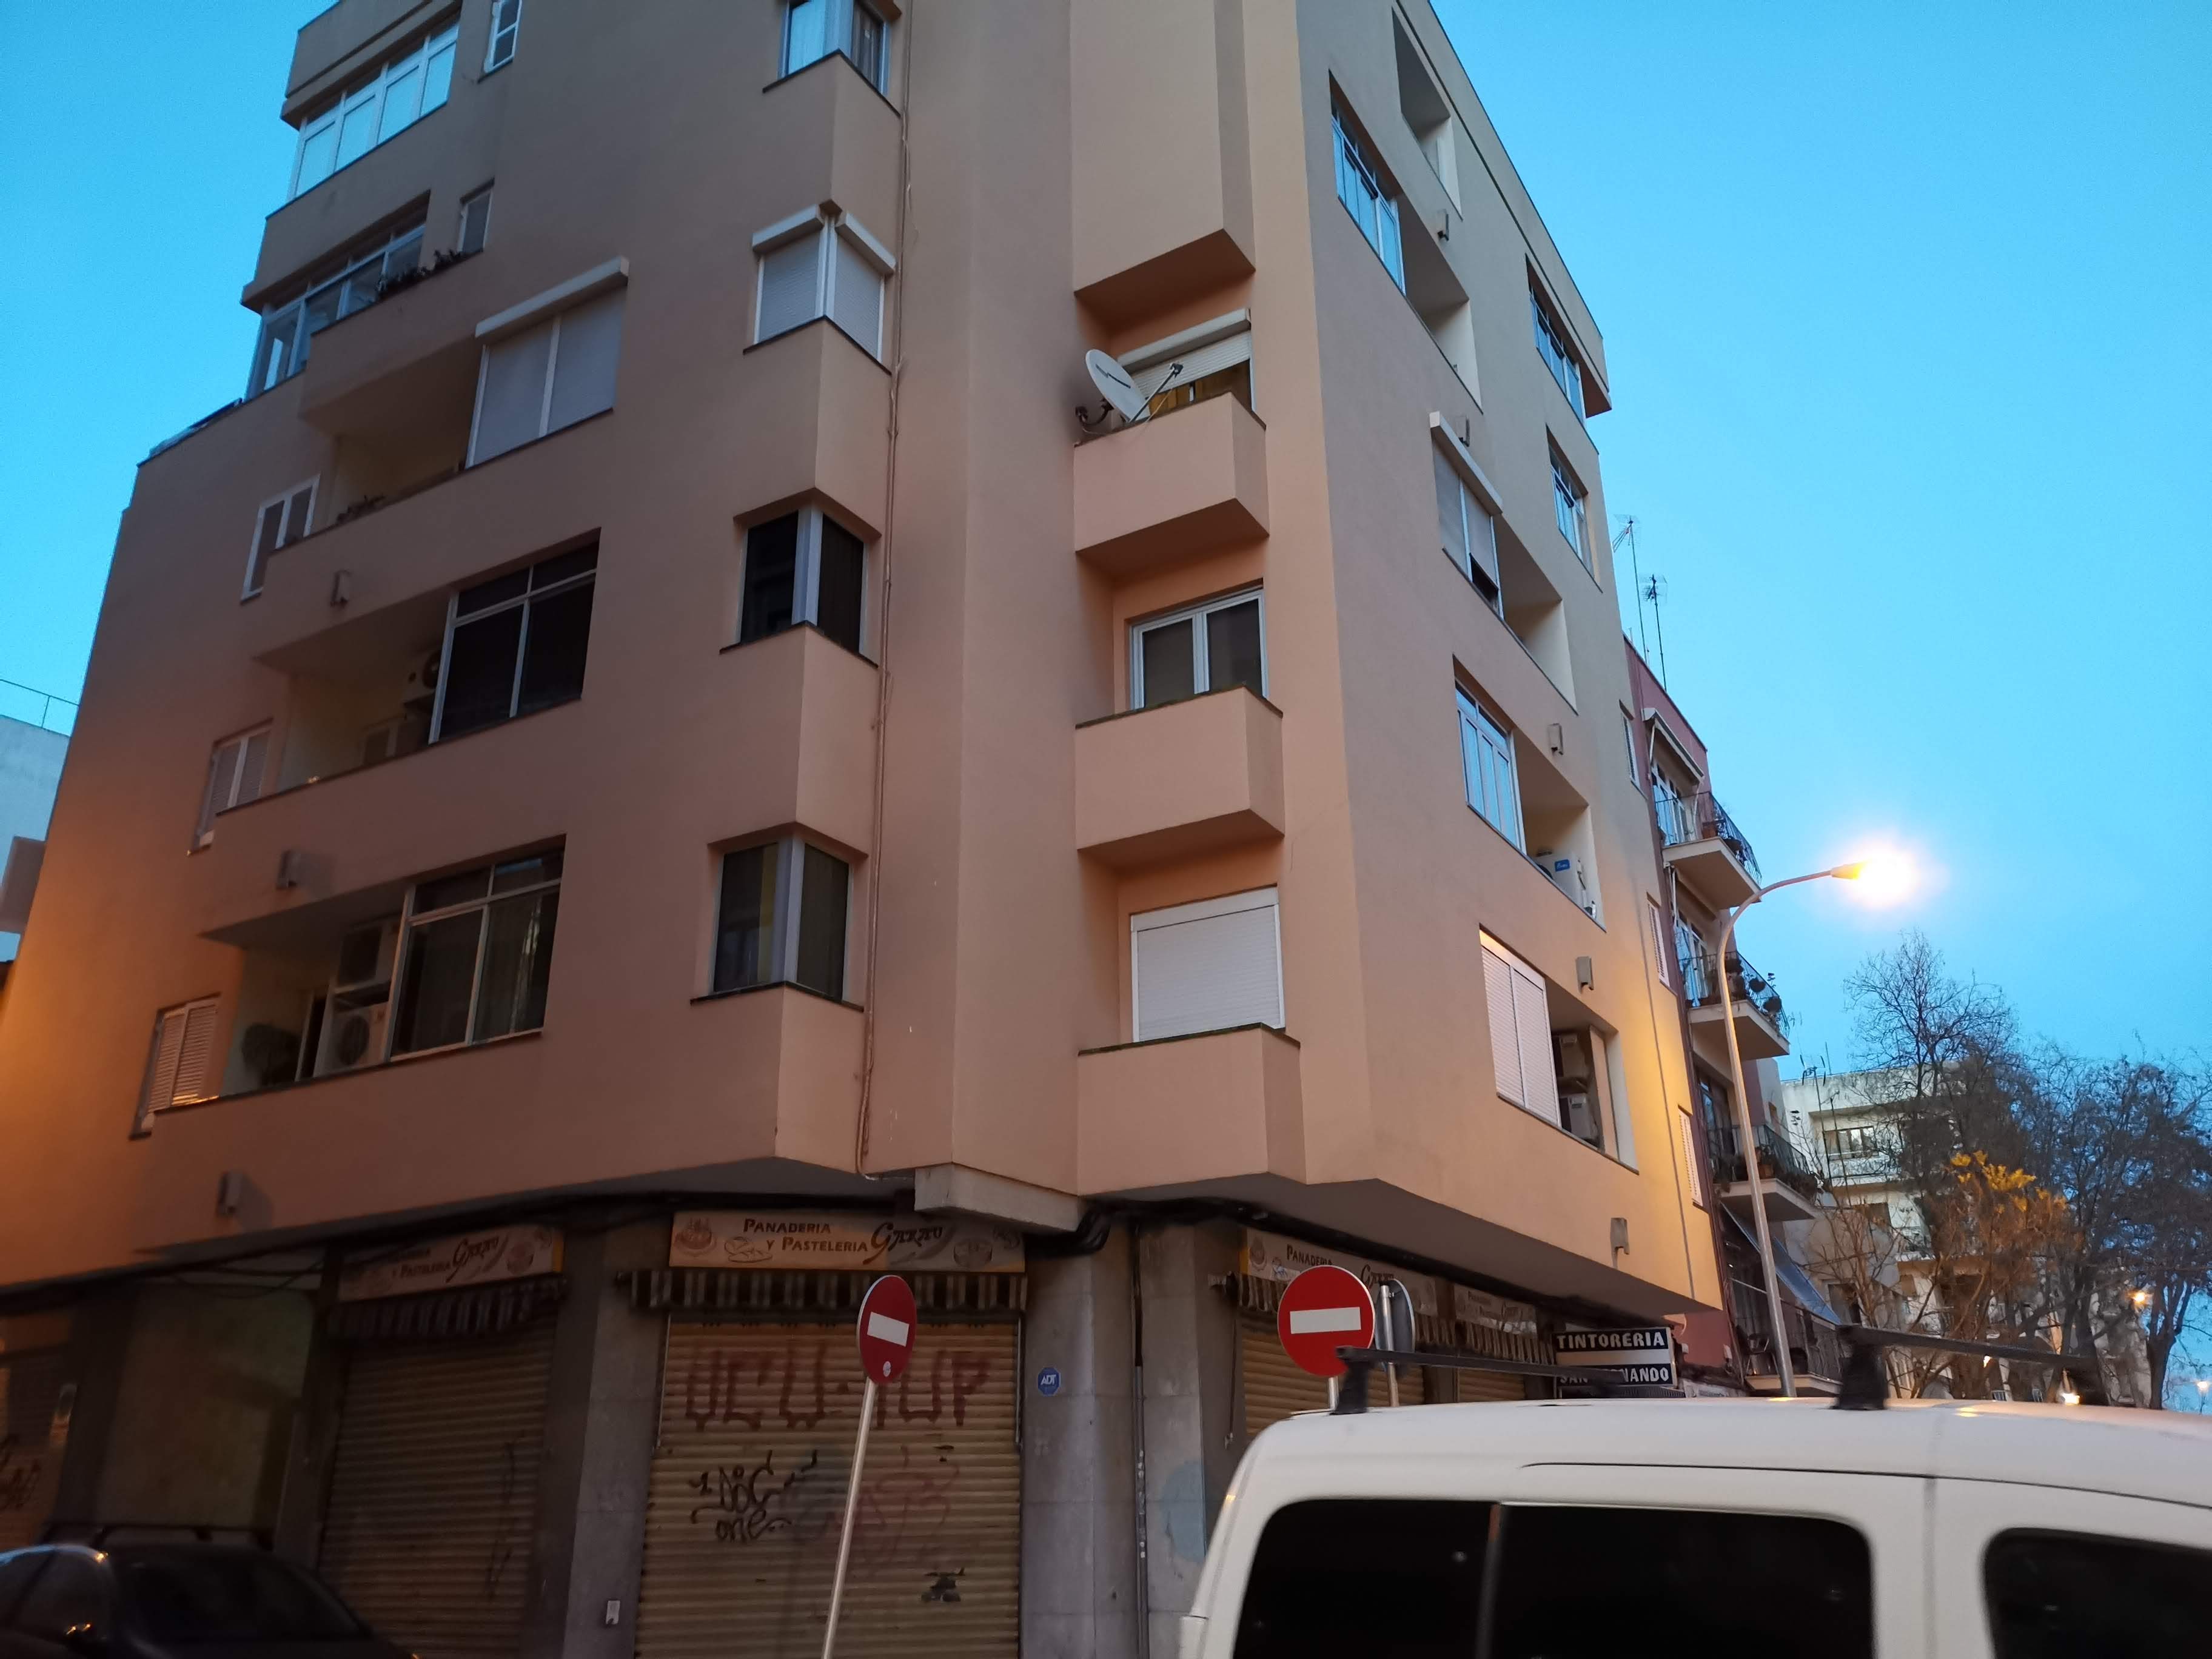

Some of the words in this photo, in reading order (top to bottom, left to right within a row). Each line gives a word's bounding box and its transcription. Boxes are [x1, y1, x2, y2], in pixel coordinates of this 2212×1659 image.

[743, 1218, 831, 1234] PANADERIA
[782, 1236, 868, 1252] PASTELERIA
[1556, 1332, 1665, 1350] TINTORERIA
[1040, 1374, 1057, 1386] ADT
